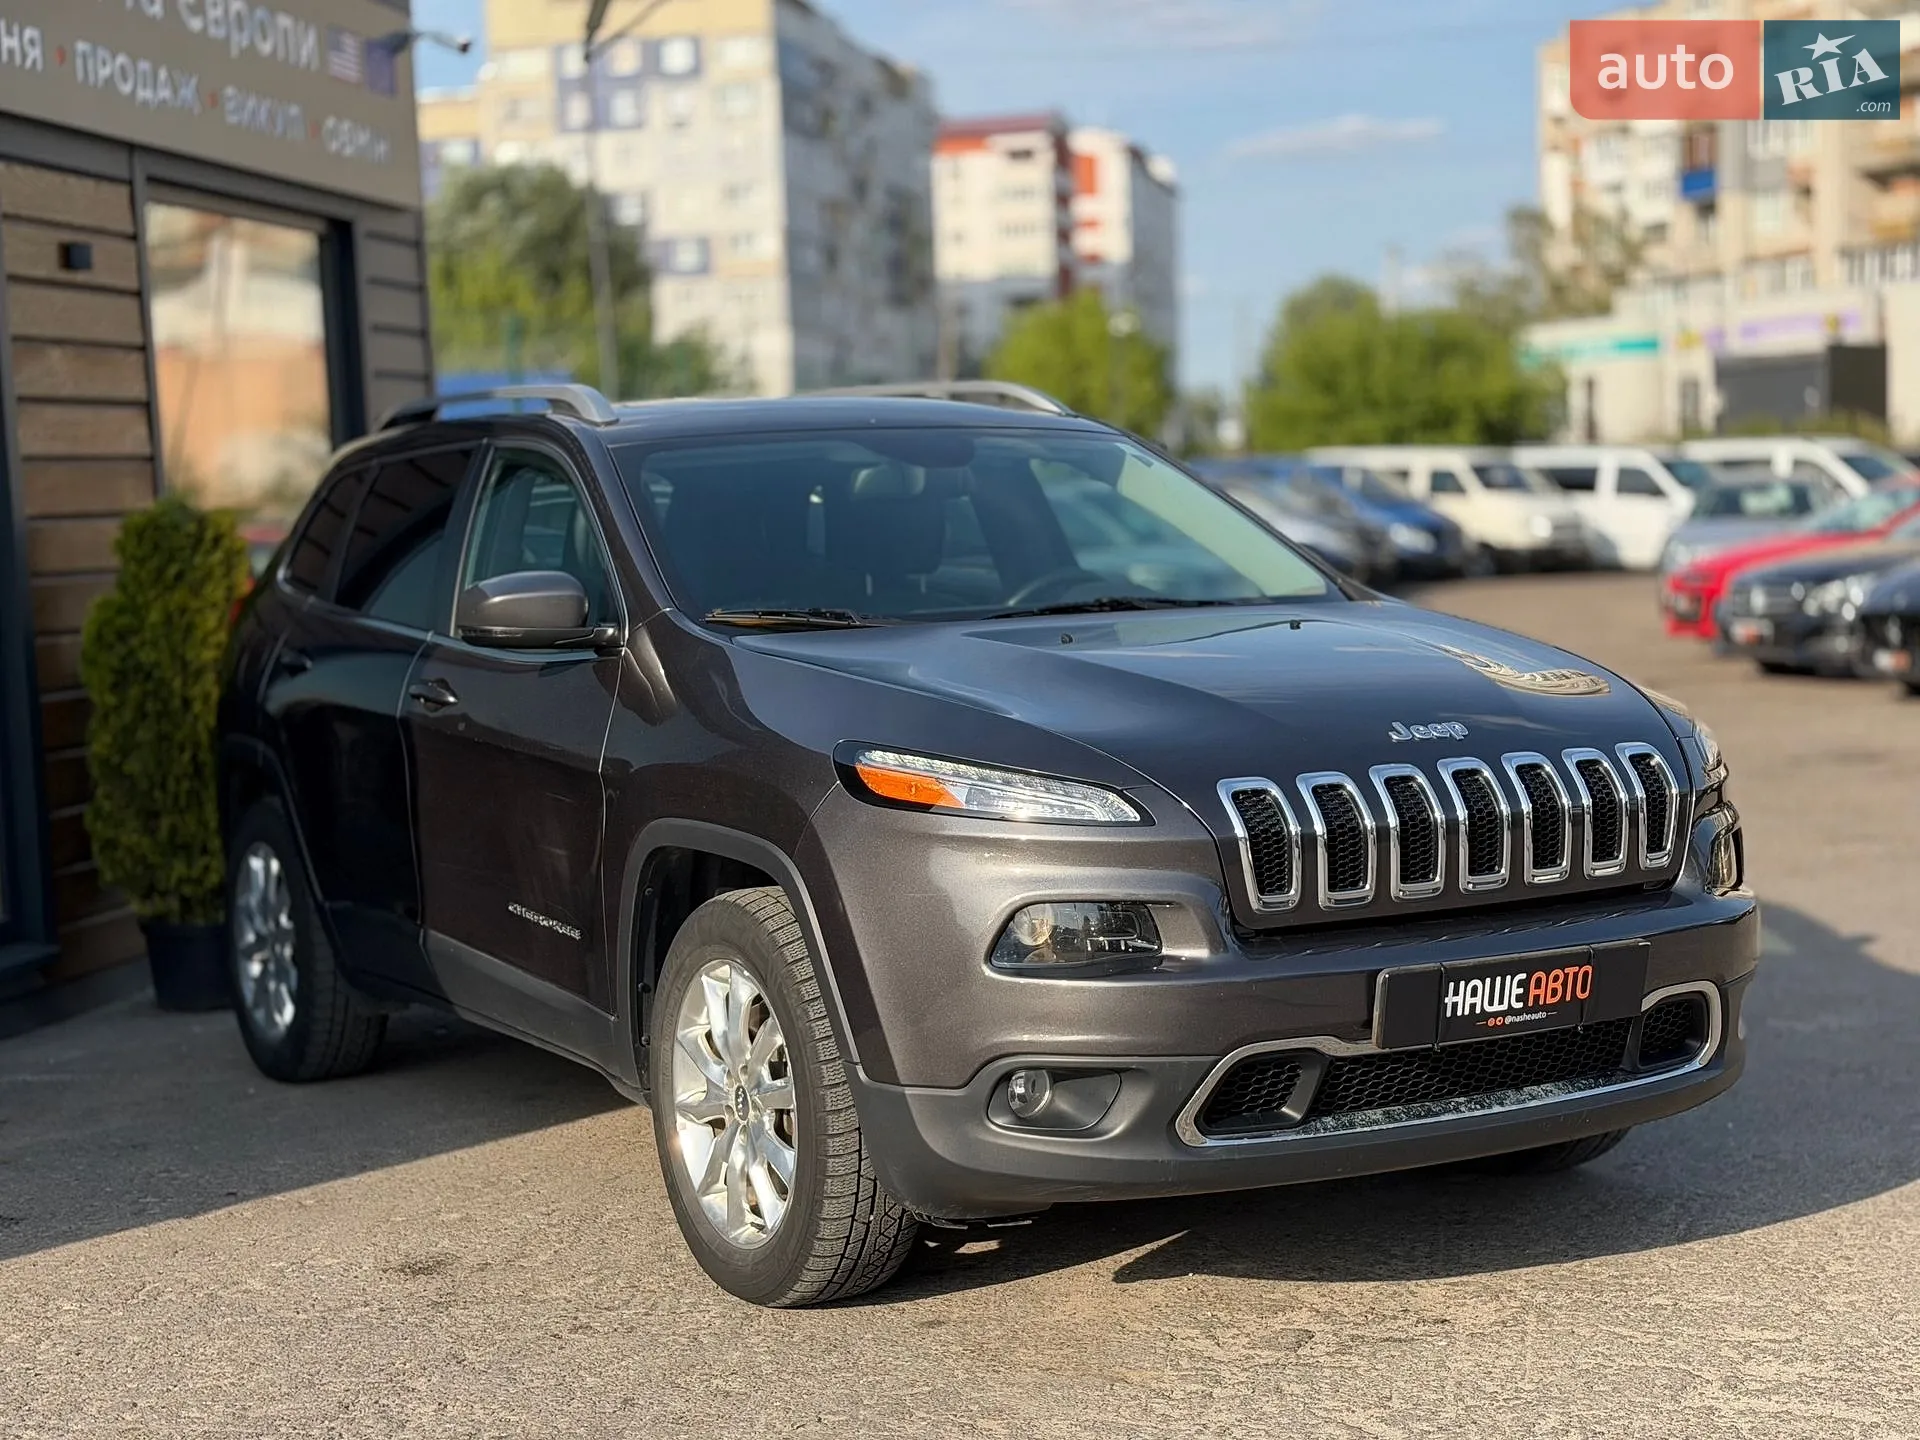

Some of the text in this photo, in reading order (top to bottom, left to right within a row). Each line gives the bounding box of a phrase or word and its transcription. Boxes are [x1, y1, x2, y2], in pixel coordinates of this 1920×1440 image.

[74, 40, 202, 115] ПРОДАЖ
[1389, 721, 1469, 742] Jeep
[1445, 965, 1593, 1018] НАШЕ АВТО
[1505, 1011, 1547, 1025] @nasheauto
